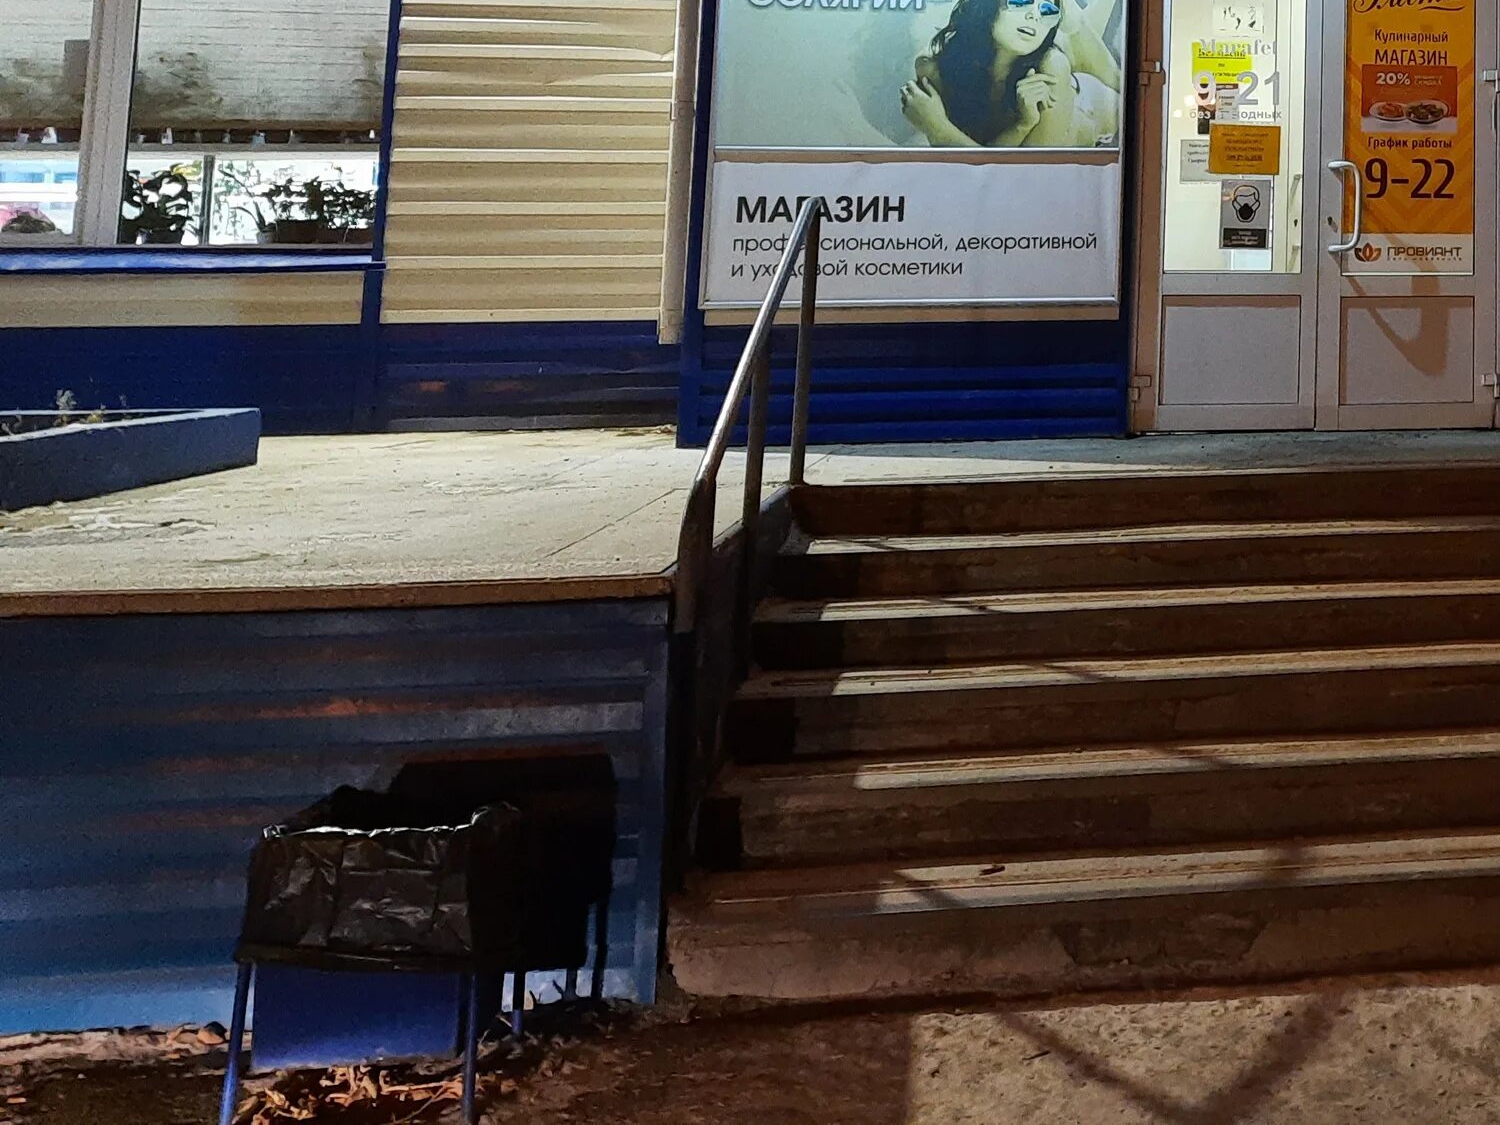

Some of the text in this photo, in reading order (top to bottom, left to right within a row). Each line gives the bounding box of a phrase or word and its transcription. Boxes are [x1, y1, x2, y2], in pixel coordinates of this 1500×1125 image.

[1374, 29, 1449, 46] Кулинарный
[1374, 49, 1449, 66] МАГАЗИН
[1375, 71, 1412, 86] 20%
[1367, 136, 1453, 151] График работы
[1365, 157, 1455, 199] 9-22
[955, 233, 1097, 258] декоративной
[1386, 246, 1463, 258] ПРОВИАНТ
[731, 264, 744, 277] и
[855, 260, 963, 277] косметики
